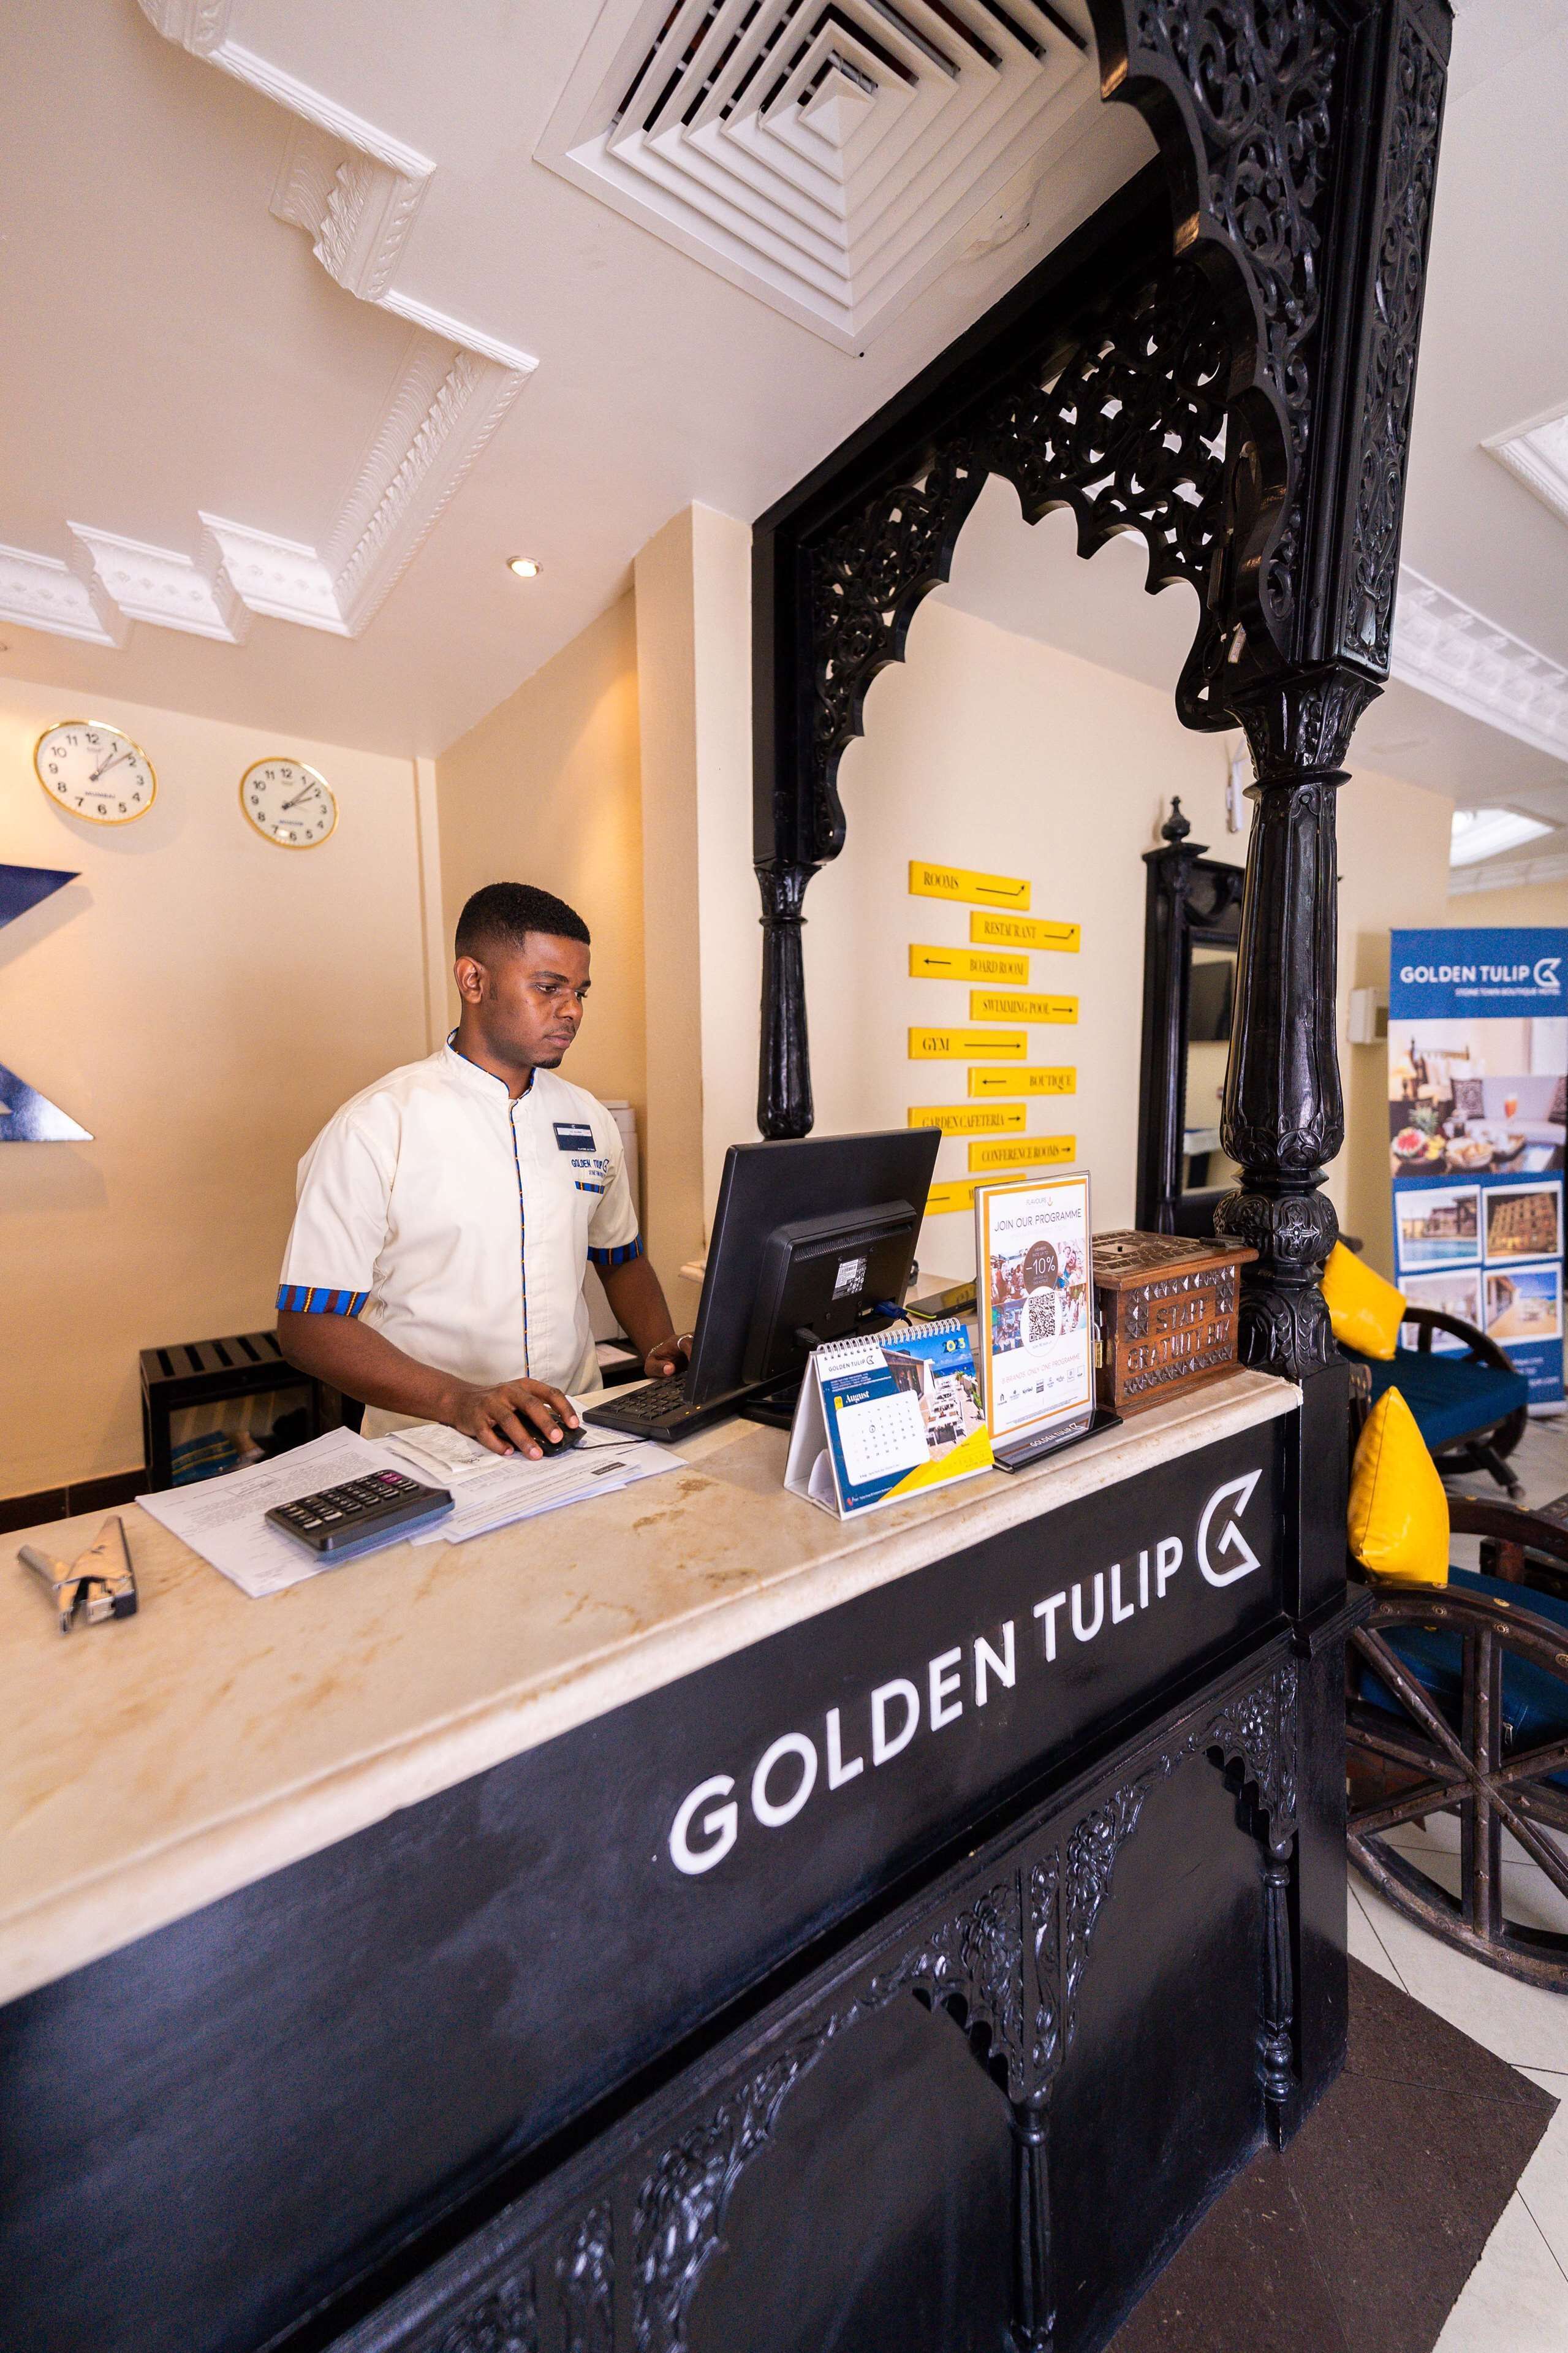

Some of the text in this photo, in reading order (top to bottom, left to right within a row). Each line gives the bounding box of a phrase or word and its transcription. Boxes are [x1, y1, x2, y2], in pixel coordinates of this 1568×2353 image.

[66, 735, 78, 745] 11
[86, 732, 100, 745] 12
[52, 747, 67, 758] 10
[112, 743, 118, 752] 1
[128, 756, 136, 767] 2
[49, 763, 58, 774] 9
[281, 768, 292, 779] 12
[137, 775, 144, 785] 3
[265, 770, 275, 780] 11
[301, 775, 306, 785] 1
[58, 781, 67, 793] 8
[253, 780, 266, 791] 10
[132, 793, 140, 802] 4
[315, 788, 321, 798] 2
[75, 796, 84, 807] 7
[251, 794, 259, 805] 9
[98, 804, 107, 815] 6
[119, 802, 126, 813] 5
[320, 804, 327, 815] 3
[258, 812, 266, 822] 8
[317, 820, 324, 829] 4
[289, 832, 297, 842] 6
[306, 829, 313, 840] 5
[923, 871, 959, 889] ROOMS
[984, 921, 1037, 939] RESTAURANT
[969, 959, 1024, 976] BOARD ROOM
[1400, 964, 1530, 984] GOLDEN TULIP
[983, 998, 1050, 1015] SWIMMING POOL
[922, 1037, 949, 1051] GYM
[1029, 1073, 1072, 1090] BOUTIQUE
[960, 1112, 1005, 1128] CAFETERIA
[982, 1144, 1059, 1163] CONFERENCE ROOMS
[572, 1158, 591, 1168] GOLDEN
[994, 1220, 1014, 1232] JOIN
[1016, 1216, 1033, 1228] OUR
[1035, 1208, 1082, 1225] PROGRAMME
[1026, 1255, 1056, 1275] -10%
[1156, 1296, 1210, 1334] STAFF
[942, 1337, 966, 1353] 2023
[1127, 1318, 1231, 1373] GRATUITY BOX
[828, 1359, 865, 1372] GOLDEN TULIP
[846, 1390, 870, 1404] August
[1030, 1434, 1056, 1447] GOLDEN
[1054, 1427, 1072, 1437] TULIP
[670, 1535, 1184, 1875] GOLDEN TULIP
